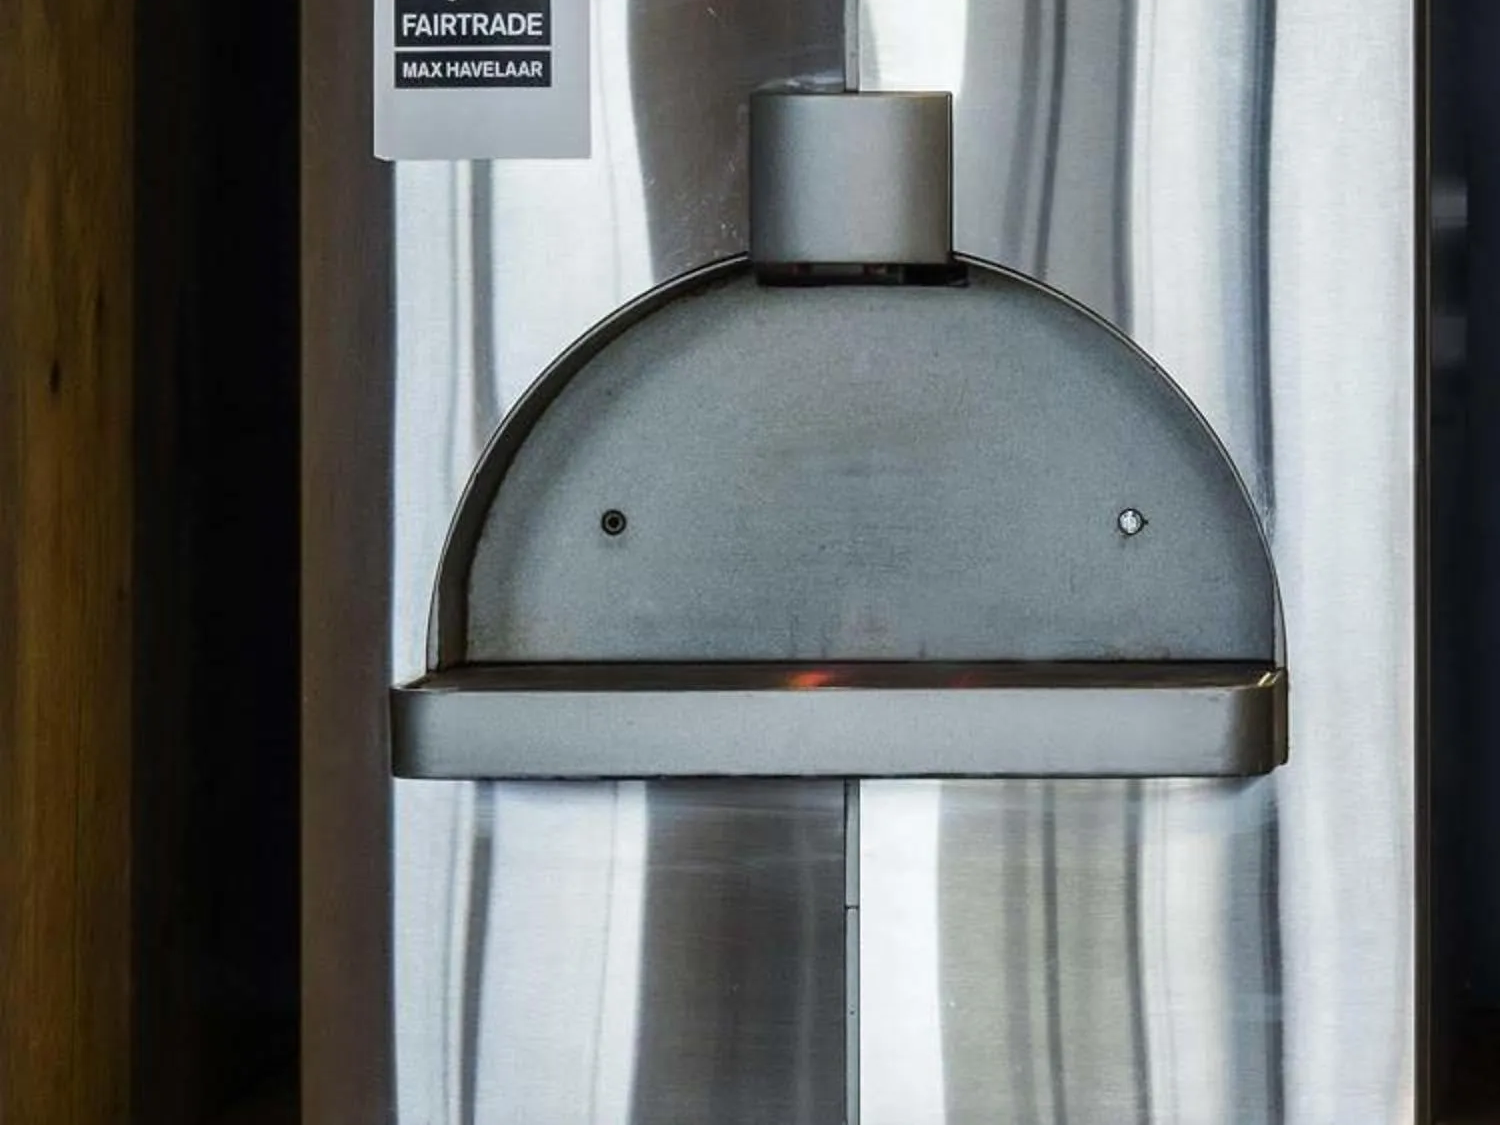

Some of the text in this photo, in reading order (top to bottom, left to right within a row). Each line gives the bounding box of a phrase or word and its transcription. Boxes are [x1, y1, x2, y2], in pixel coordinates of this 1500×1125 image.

[403, 12, 543, 36] FAIRTRADE
[403, 61, 543, 78] MAX HAVELAAR
